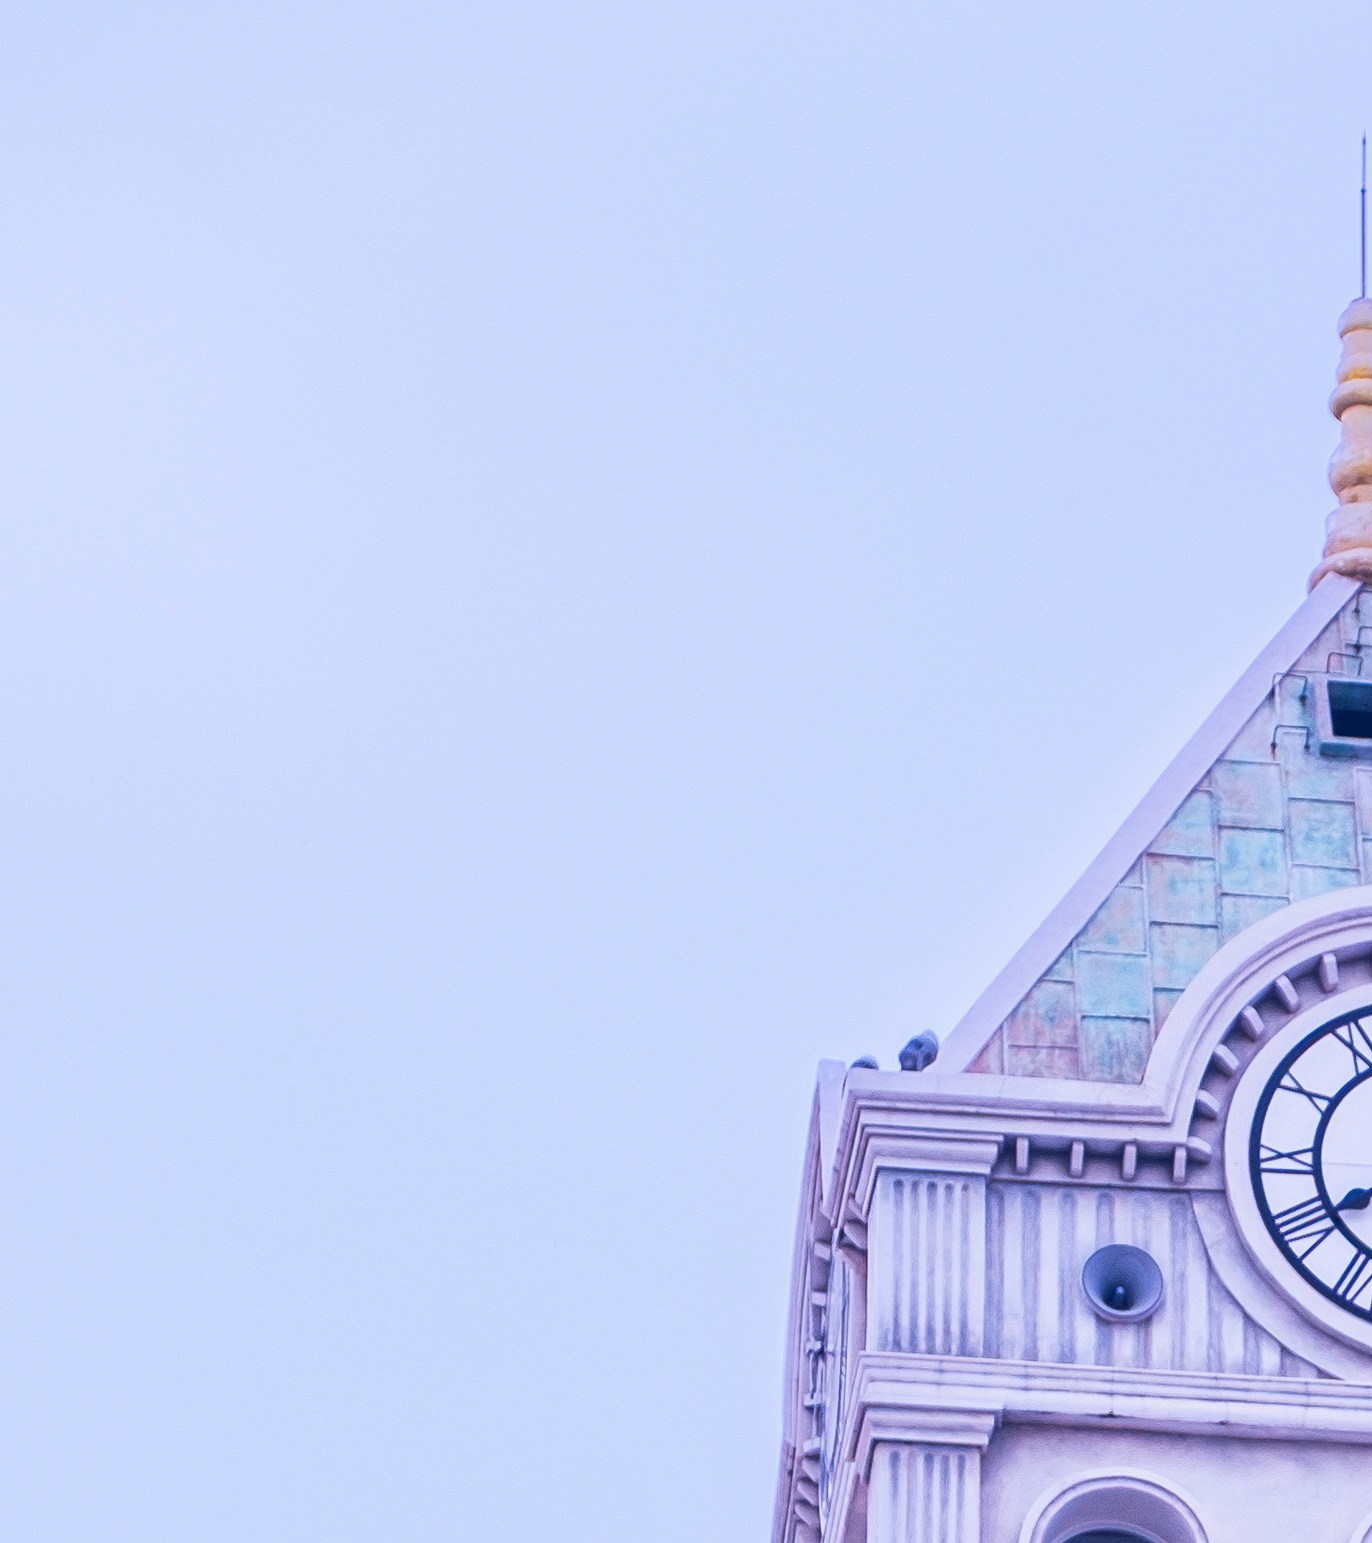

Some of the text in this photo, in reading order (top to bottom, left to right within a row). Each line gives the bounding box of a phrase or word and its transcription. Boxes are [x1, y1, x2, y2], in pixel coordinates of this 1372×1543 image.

[1276, 1069, 1333, 1116] X
[1259, 1144, 1314, 1175] IX
[1271, 1194, 1337, 1262] VIII
